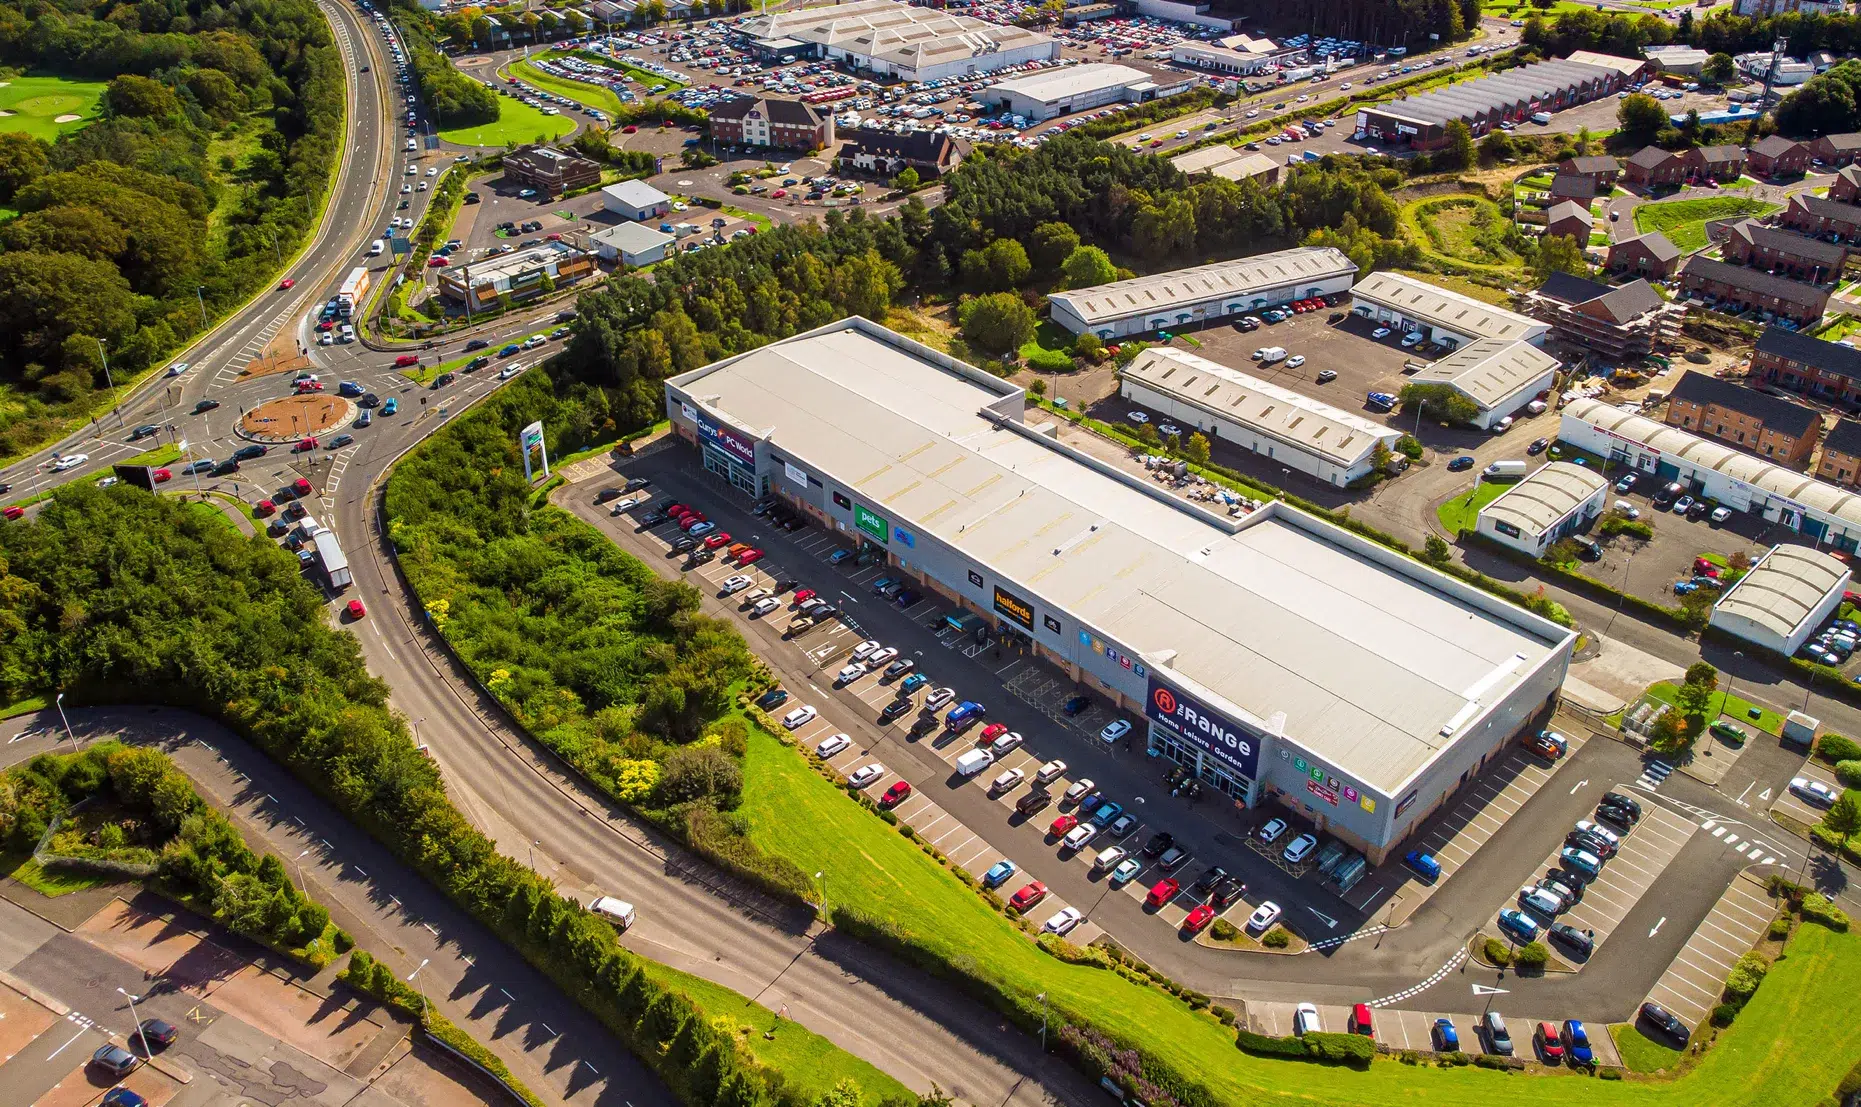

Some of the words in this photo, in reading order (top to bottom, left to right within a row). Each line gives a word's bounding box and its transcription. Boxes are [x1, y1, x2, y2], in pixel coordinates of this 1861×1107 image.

[698, 419, 718, 437] Currys
[726, 436, 735, 447] PC
[736, 442, 753, 458] World
[861, 511, 880, 528] pets
[996, 592, 1030, 619] halfords
[1158, 713, 1179, 730] Home
[1184, 728, 1210, 748] Leisure
[1214, 748, 1242, 768] Garden
